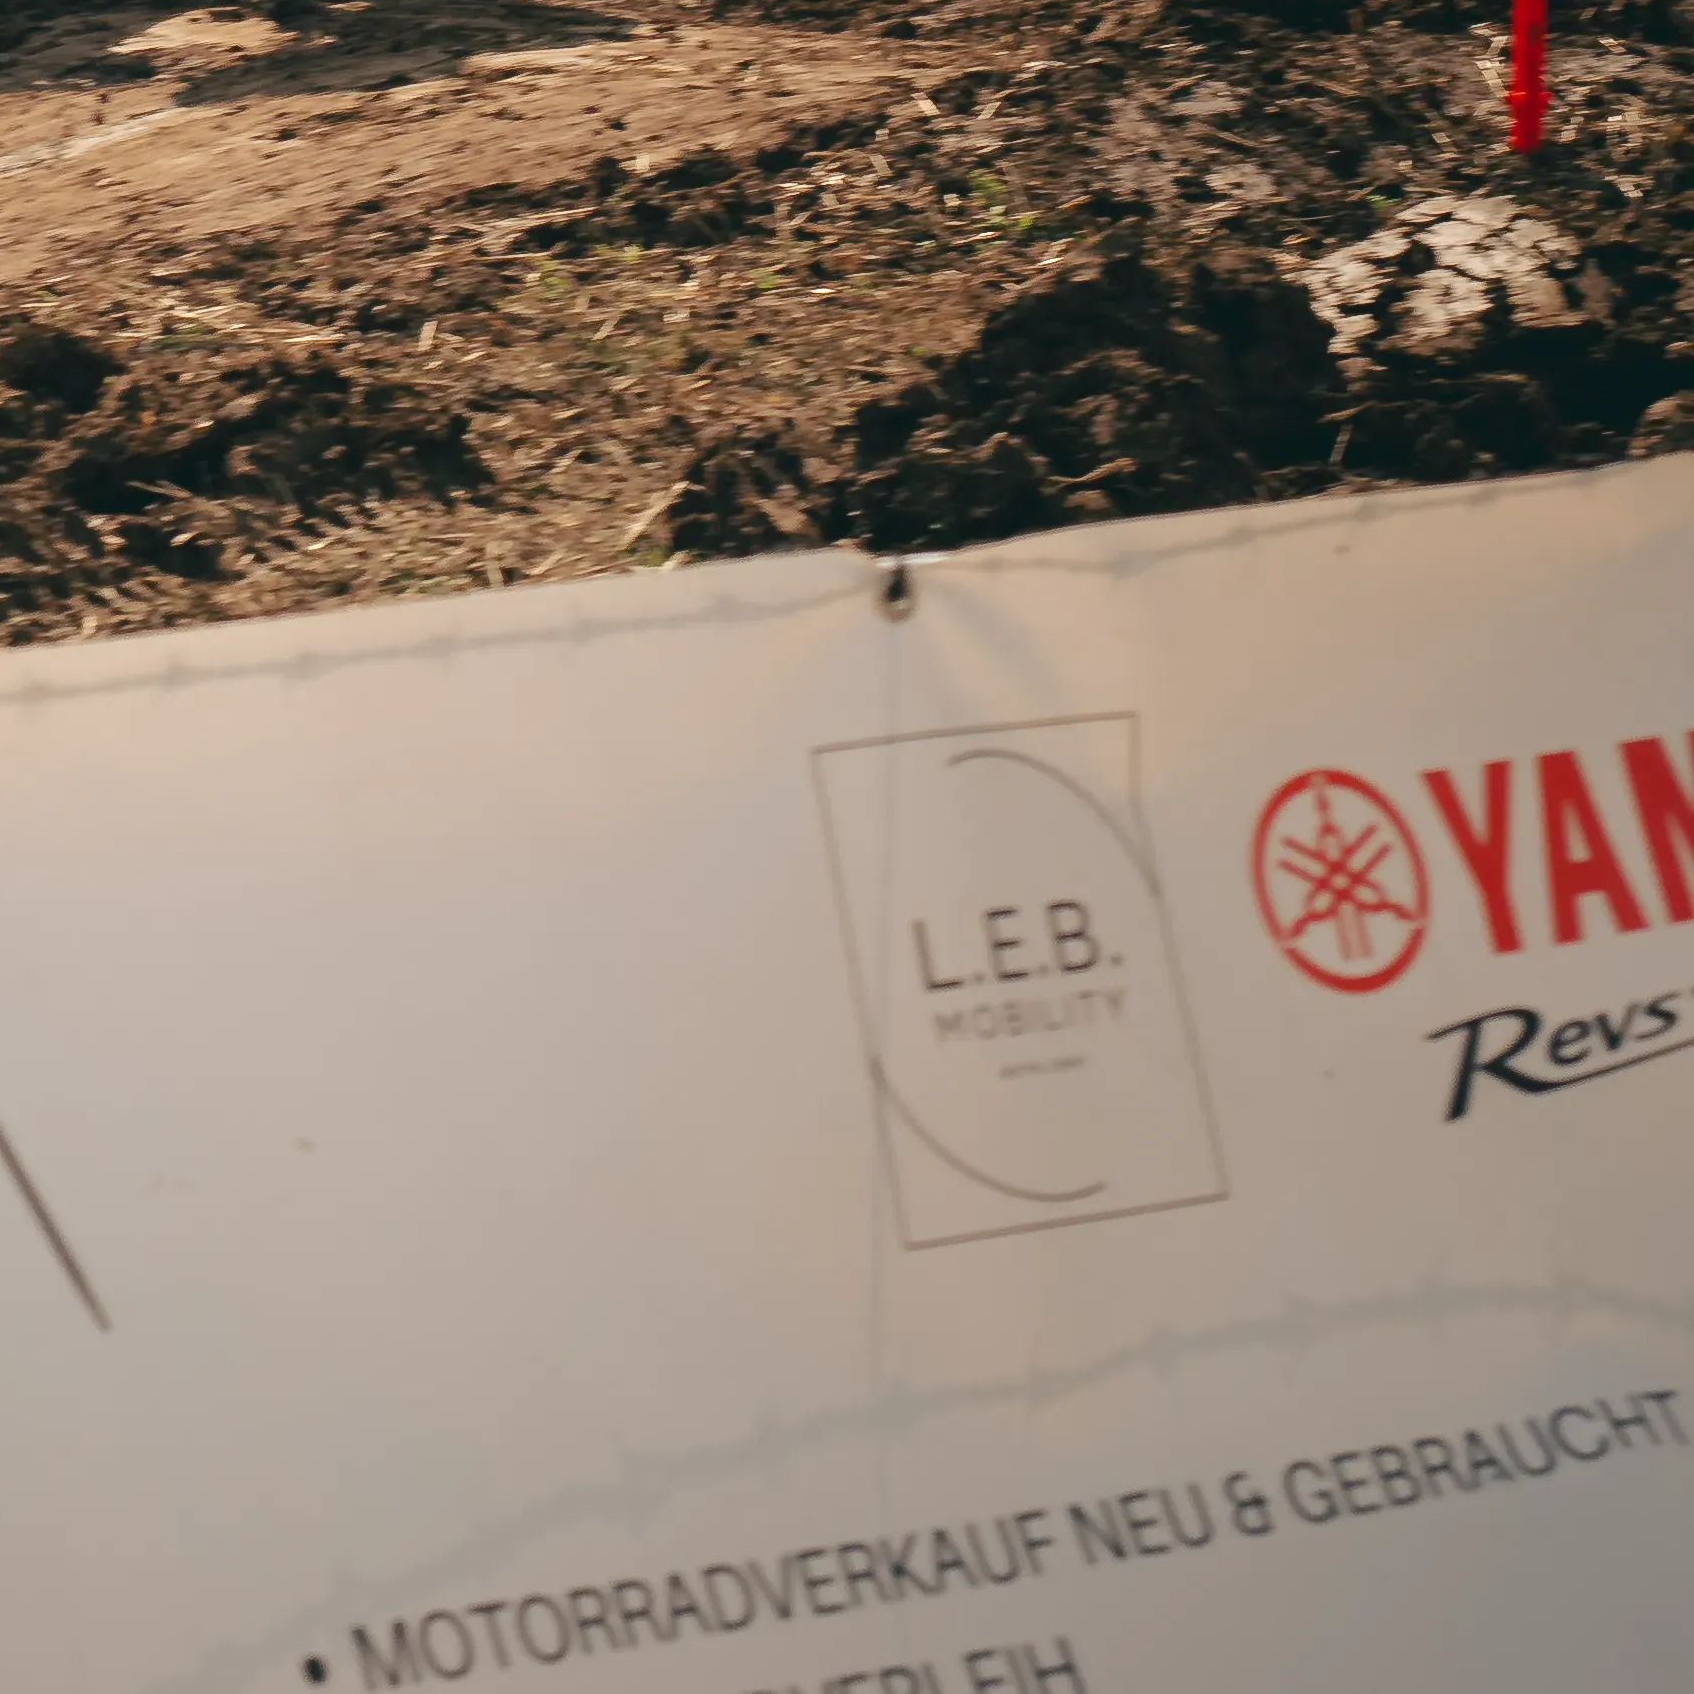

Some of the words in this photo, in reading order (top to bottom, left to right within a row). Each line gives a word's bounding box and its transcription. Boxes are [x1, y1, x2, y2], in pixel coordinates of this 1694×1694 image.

[910, 898, 1125, 992] L.E.B.
[350, 1507, 1055, 1693] MOTORRADVERKAUF
[1068, 1480, 1216, 1568] NEU
[1221, 1468, 1274, 1538] &
[1281, 1388, 1691, 1526] GEBRAUCHT
